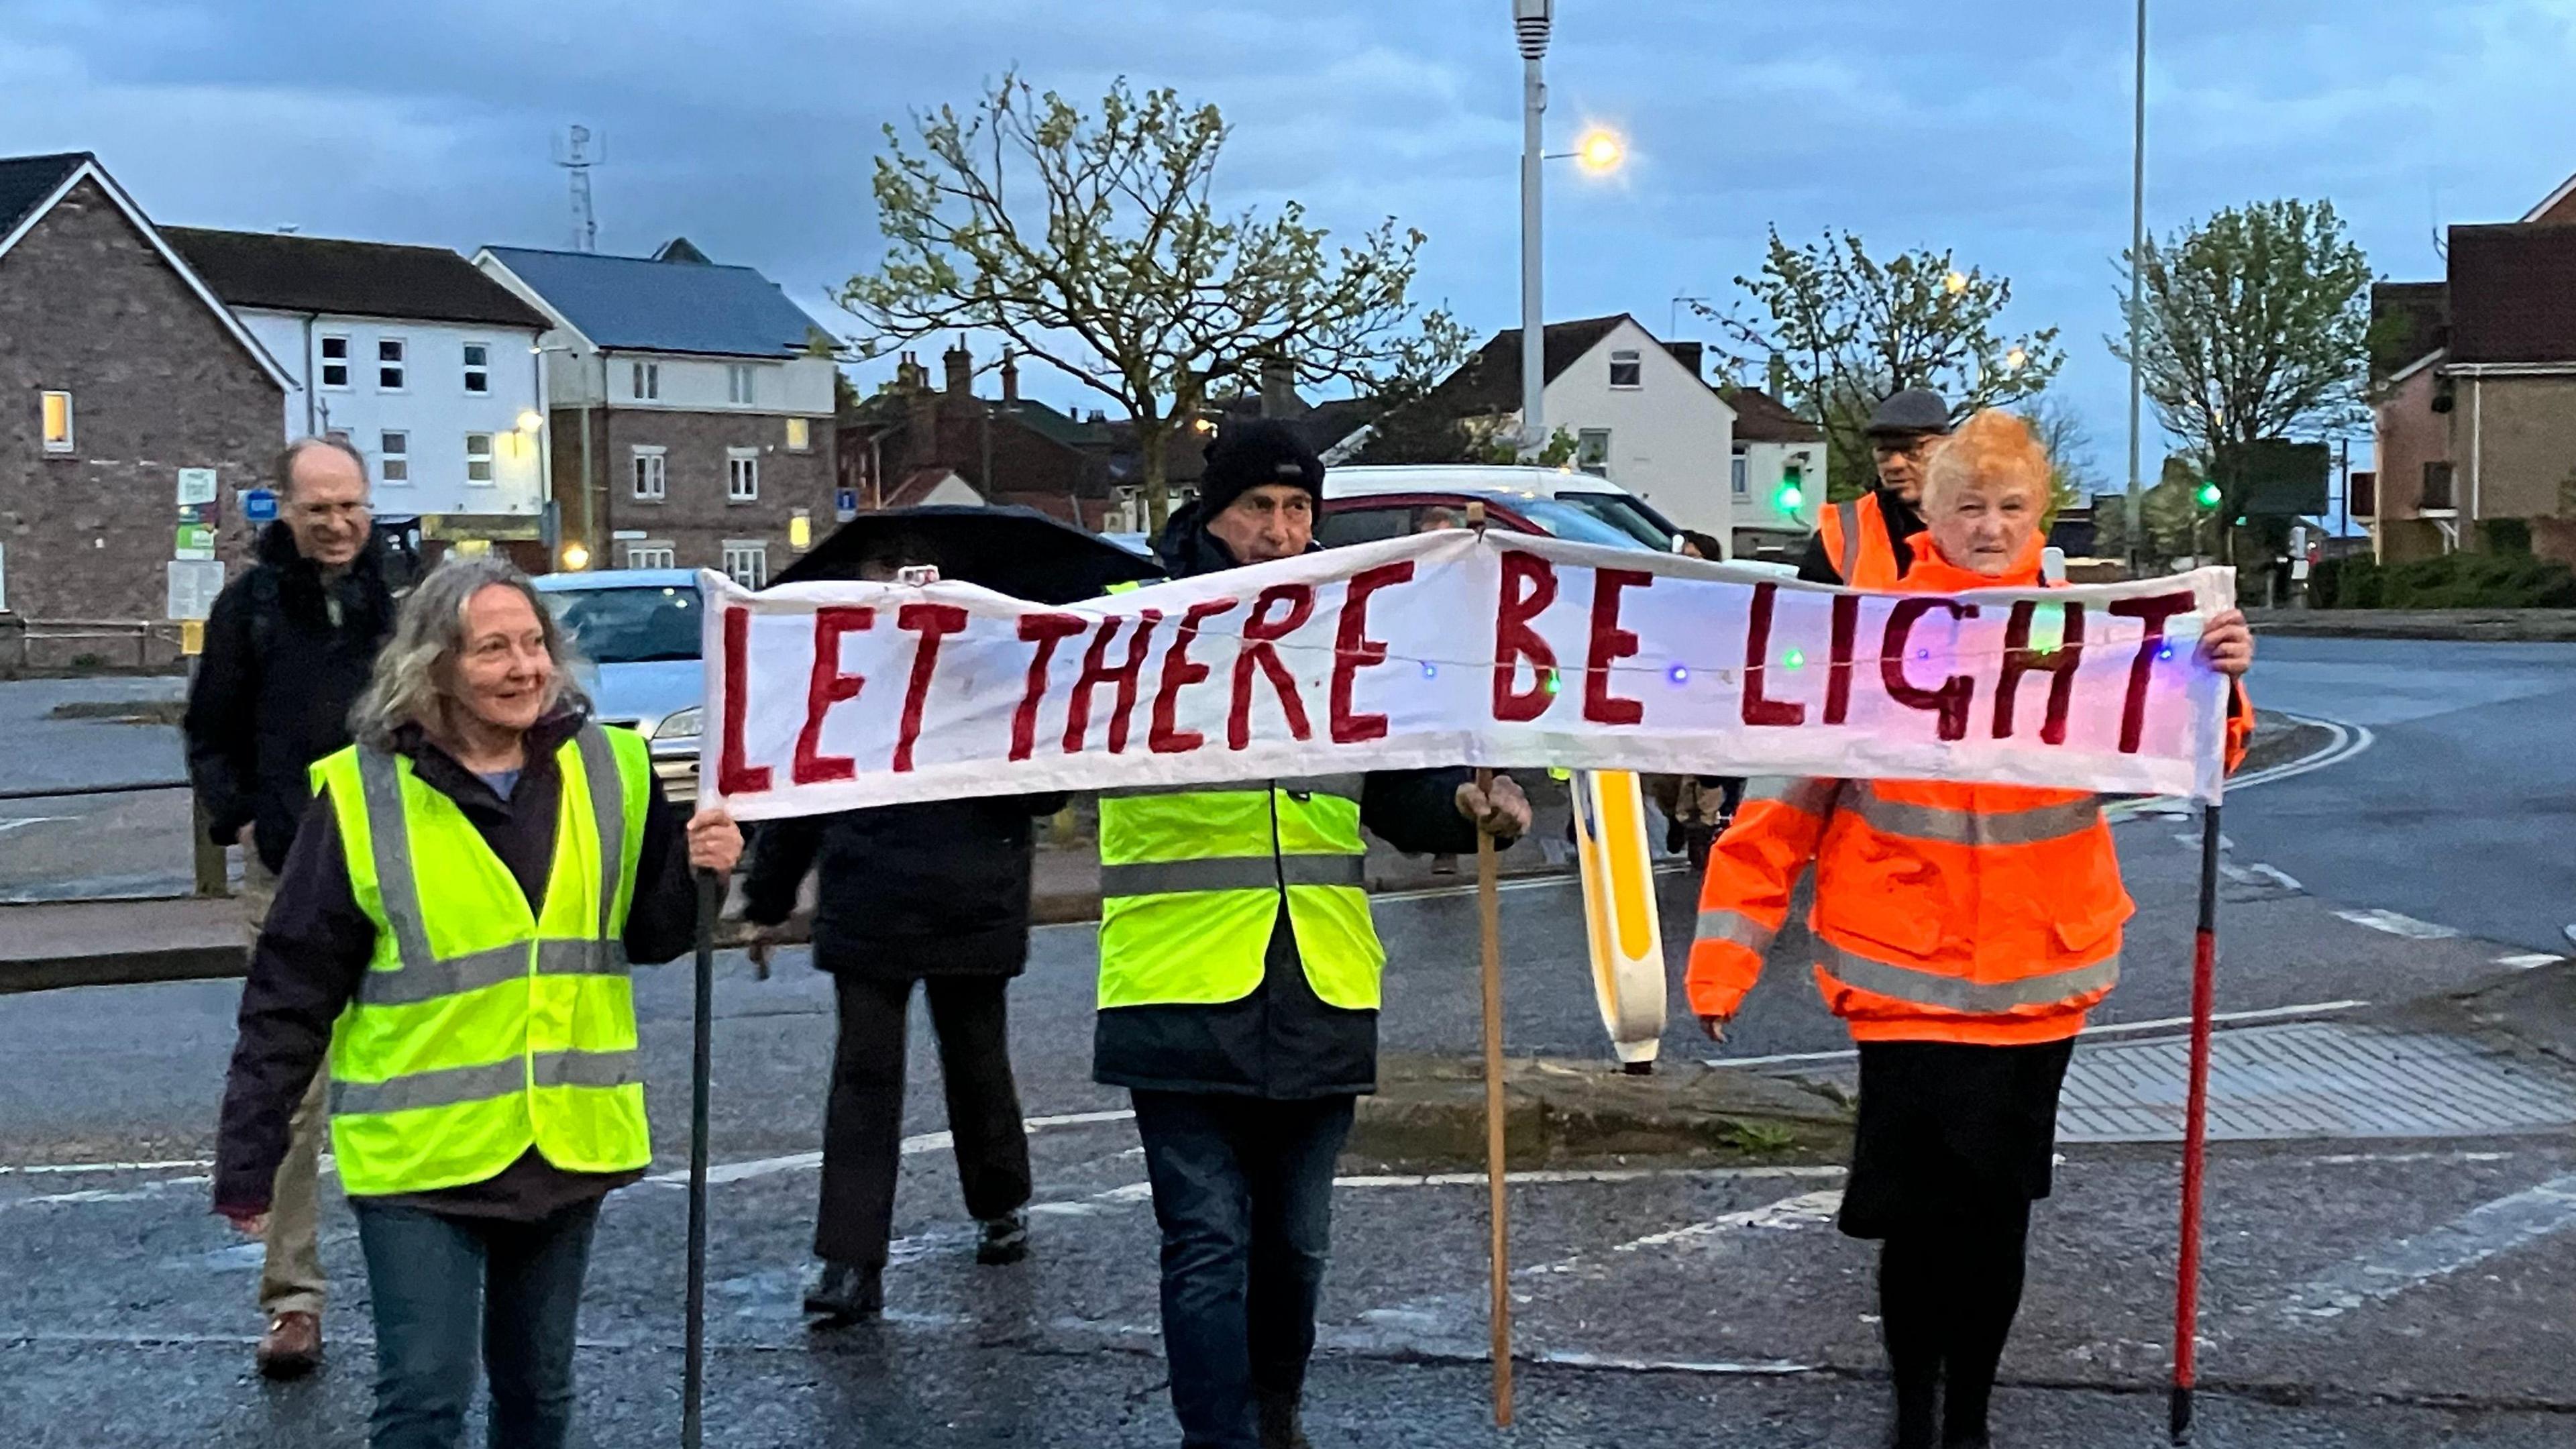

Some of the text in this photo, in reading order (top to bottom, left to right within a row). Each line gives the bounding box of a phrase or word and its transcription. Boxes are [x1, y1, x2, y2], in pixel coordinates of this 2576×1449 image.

[718, 550, 2195, 796] LET THERE BE LIGHT
